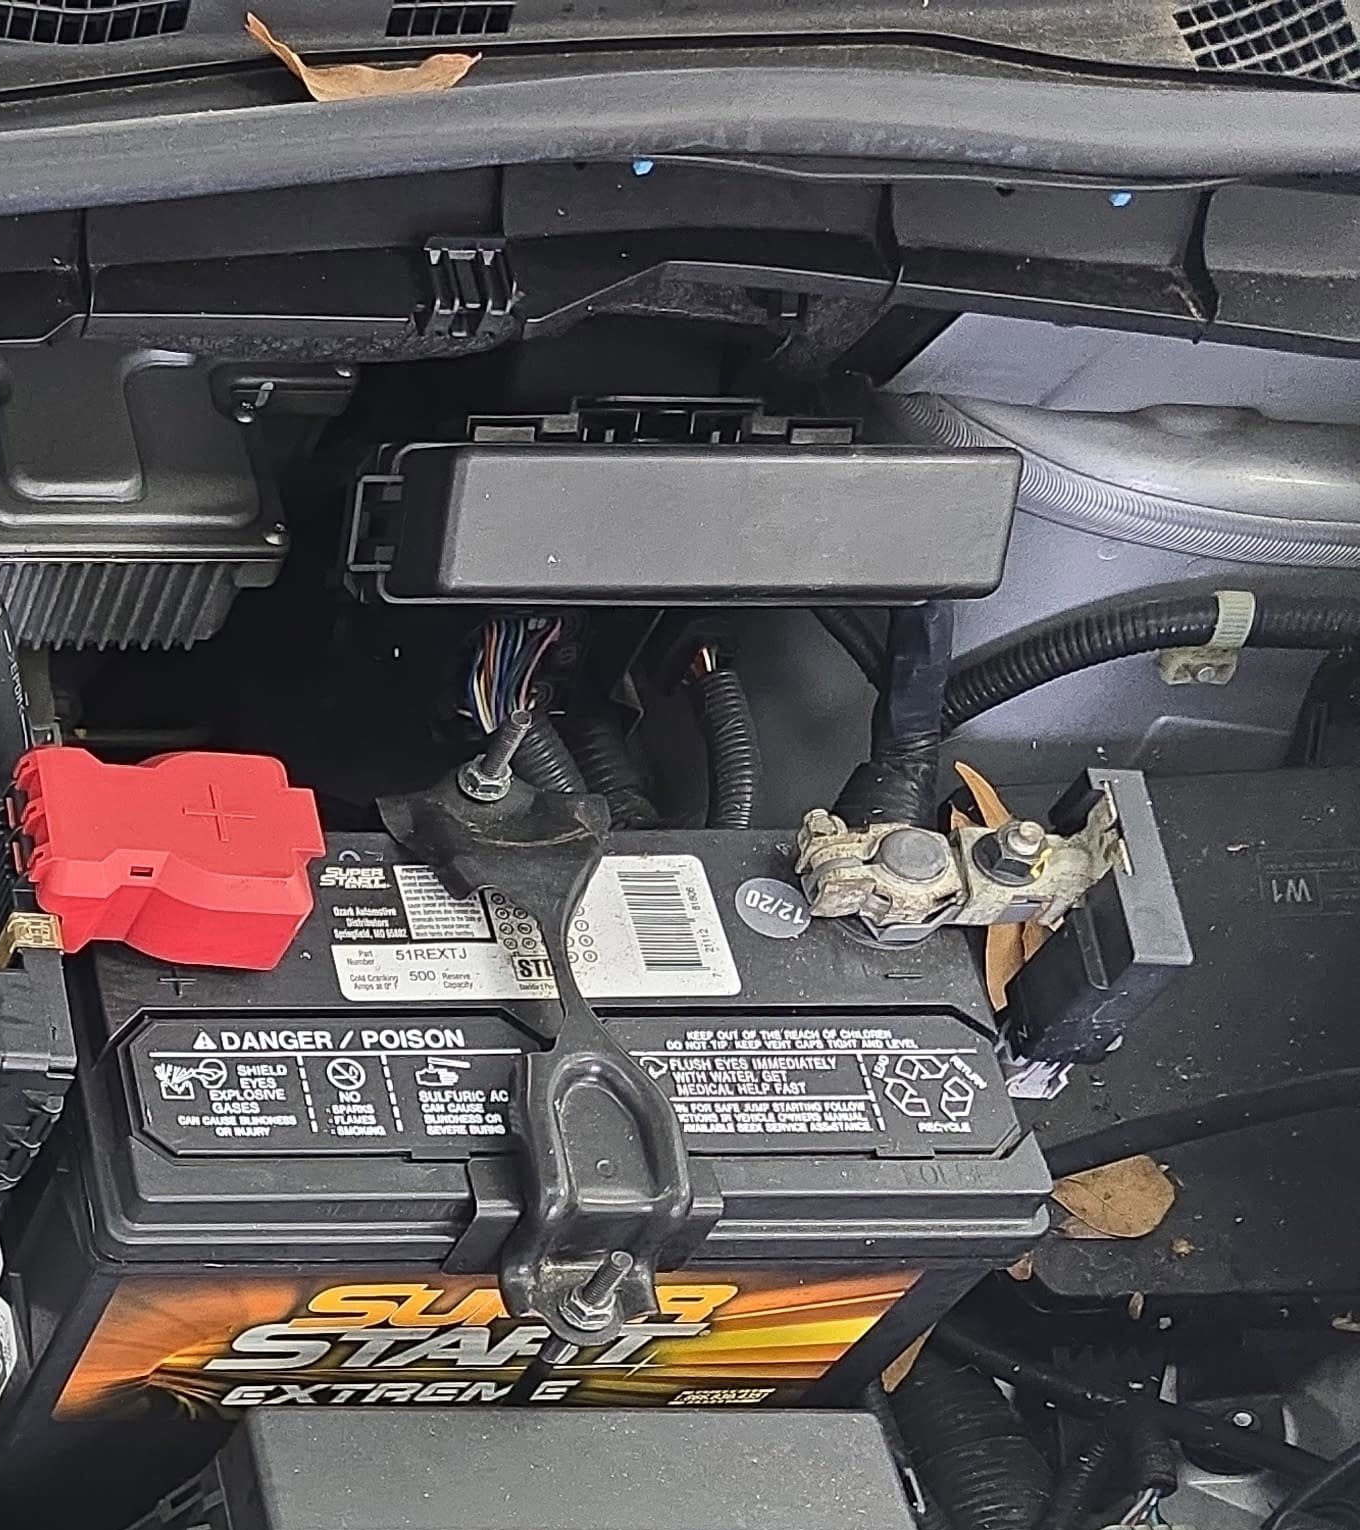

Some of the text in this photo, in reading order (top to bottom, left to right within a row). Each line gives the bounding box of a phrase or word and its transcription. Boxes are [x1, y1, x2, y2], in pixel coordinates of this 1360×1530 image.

[325, 867, 384, 876] SUPER
[320, 875, 385, 886] START
[745, 889, 805, 925] 12/20
[358, 950, 373, 958] Part
[395, 948, 468, 961] 51REXTJ
[347, 958, 375, 966] Number
[409, 970, 436, 981] 500
[220, 1031, 334, 1050] DANGER
[361, 1029, 465, 1049] POISON
[686, 1030, 714, 1040] KEEP
[716, 1030, 739, 1040] OUT
[669, 1056, 837, 1070] FLUSH EYES IMMEDIATELY
[237, 1064, 288, 1076] SHIELD
[672, 1070, 788, 1082] WITH GET
[240, 1078, 277, 1089] EYES
[676, 1082, 806, 1096] MEDICAL HELP FAST
[209, 1088, 287, 1100] EXPLOSIVE
[339, 1092, 361, 1102] NO
[418, 1090, 485, 1102] SULFURIC
[212, 1102, 261, 1114] GASES
[918, 1122, 971, 1132] RECYCLE
[288, 1284, 739, 1327] SUR
